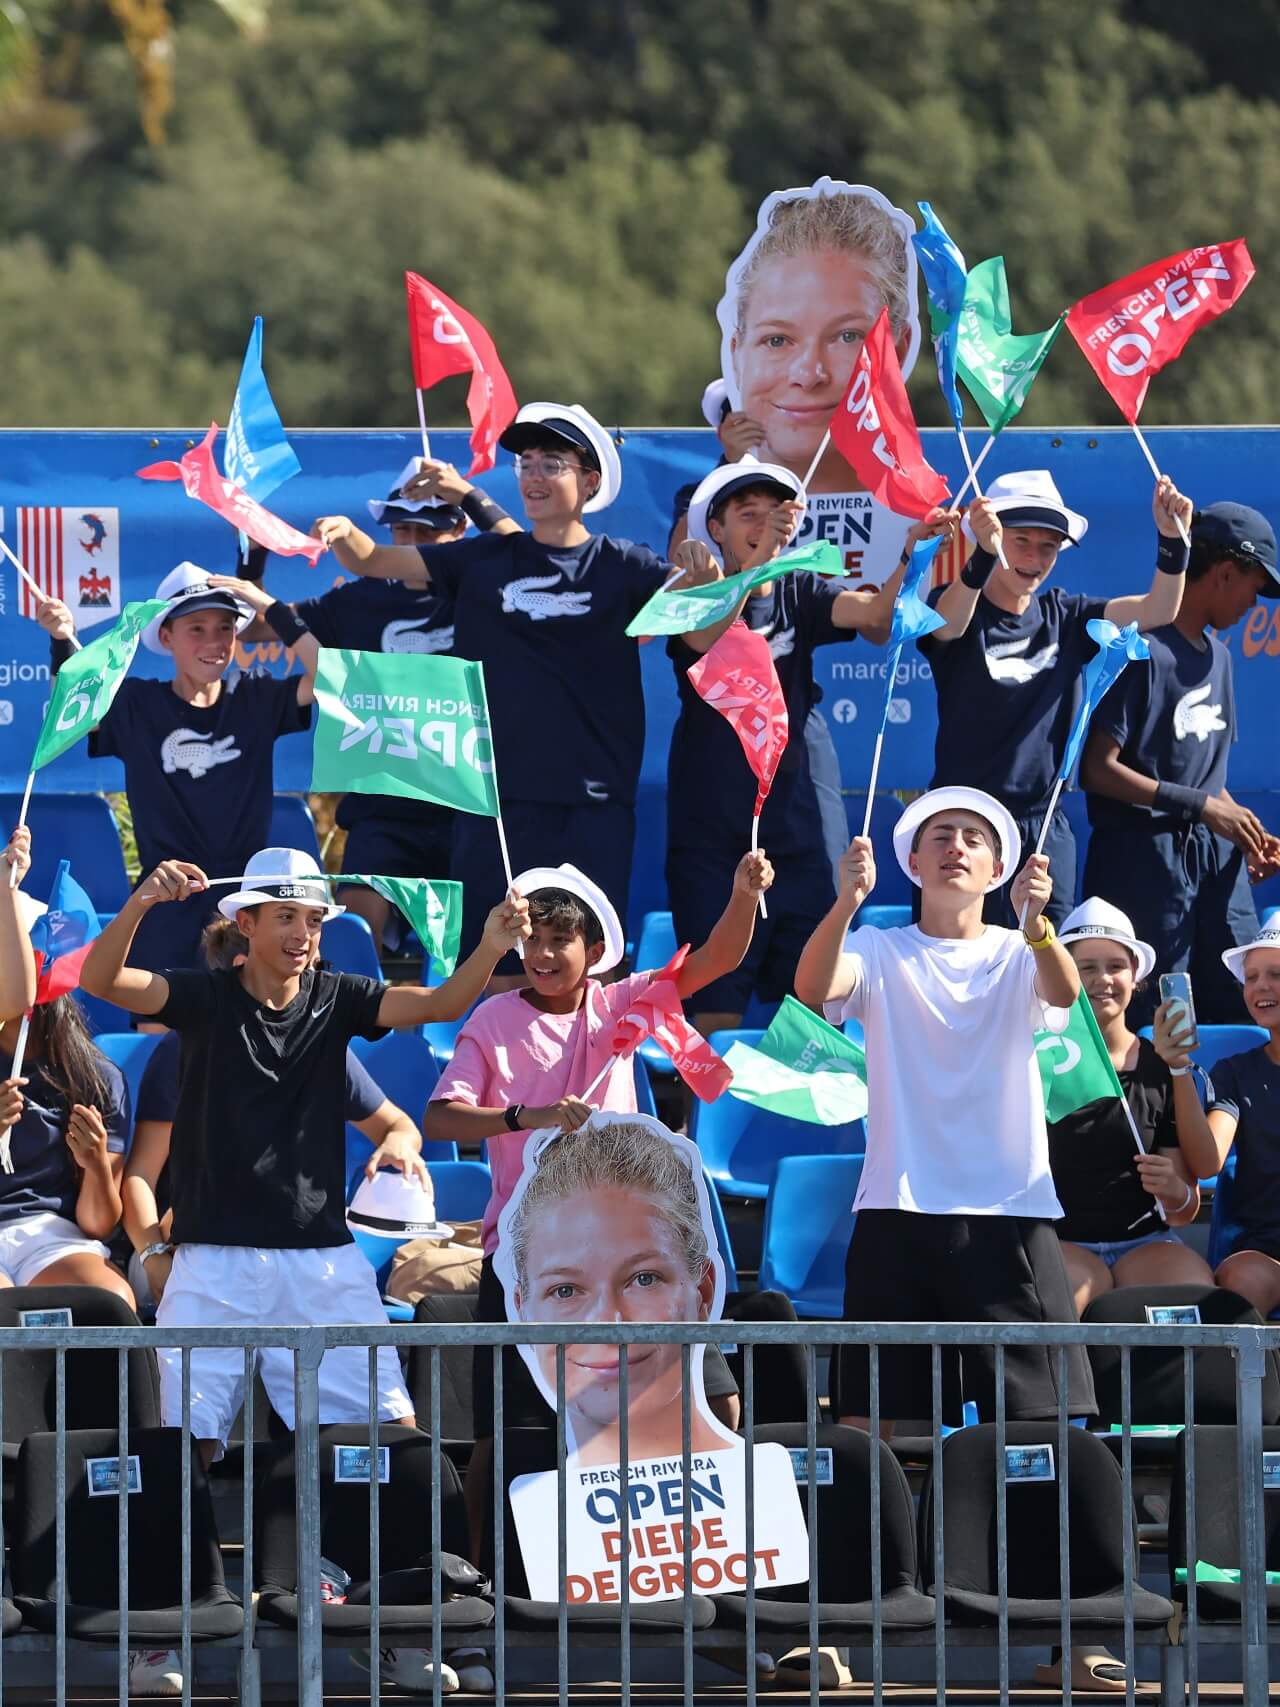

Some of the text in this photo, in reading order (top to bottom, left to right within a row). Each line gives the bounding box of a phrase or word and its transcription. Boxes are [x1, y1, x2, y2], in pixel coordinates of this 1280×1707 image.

[1086, 288, 1156, 350] FRENCH
[816, 497, 873, 510] RIVIERA
[788, 512, 872, 547] PEN
[279, 889, 306, 897] OPEN
[586, 1474, 726, 1524] OPEN
[601, 1517, 728, 1562] DIEDE
[566, 1548, 780, 1605] DE GROOT
